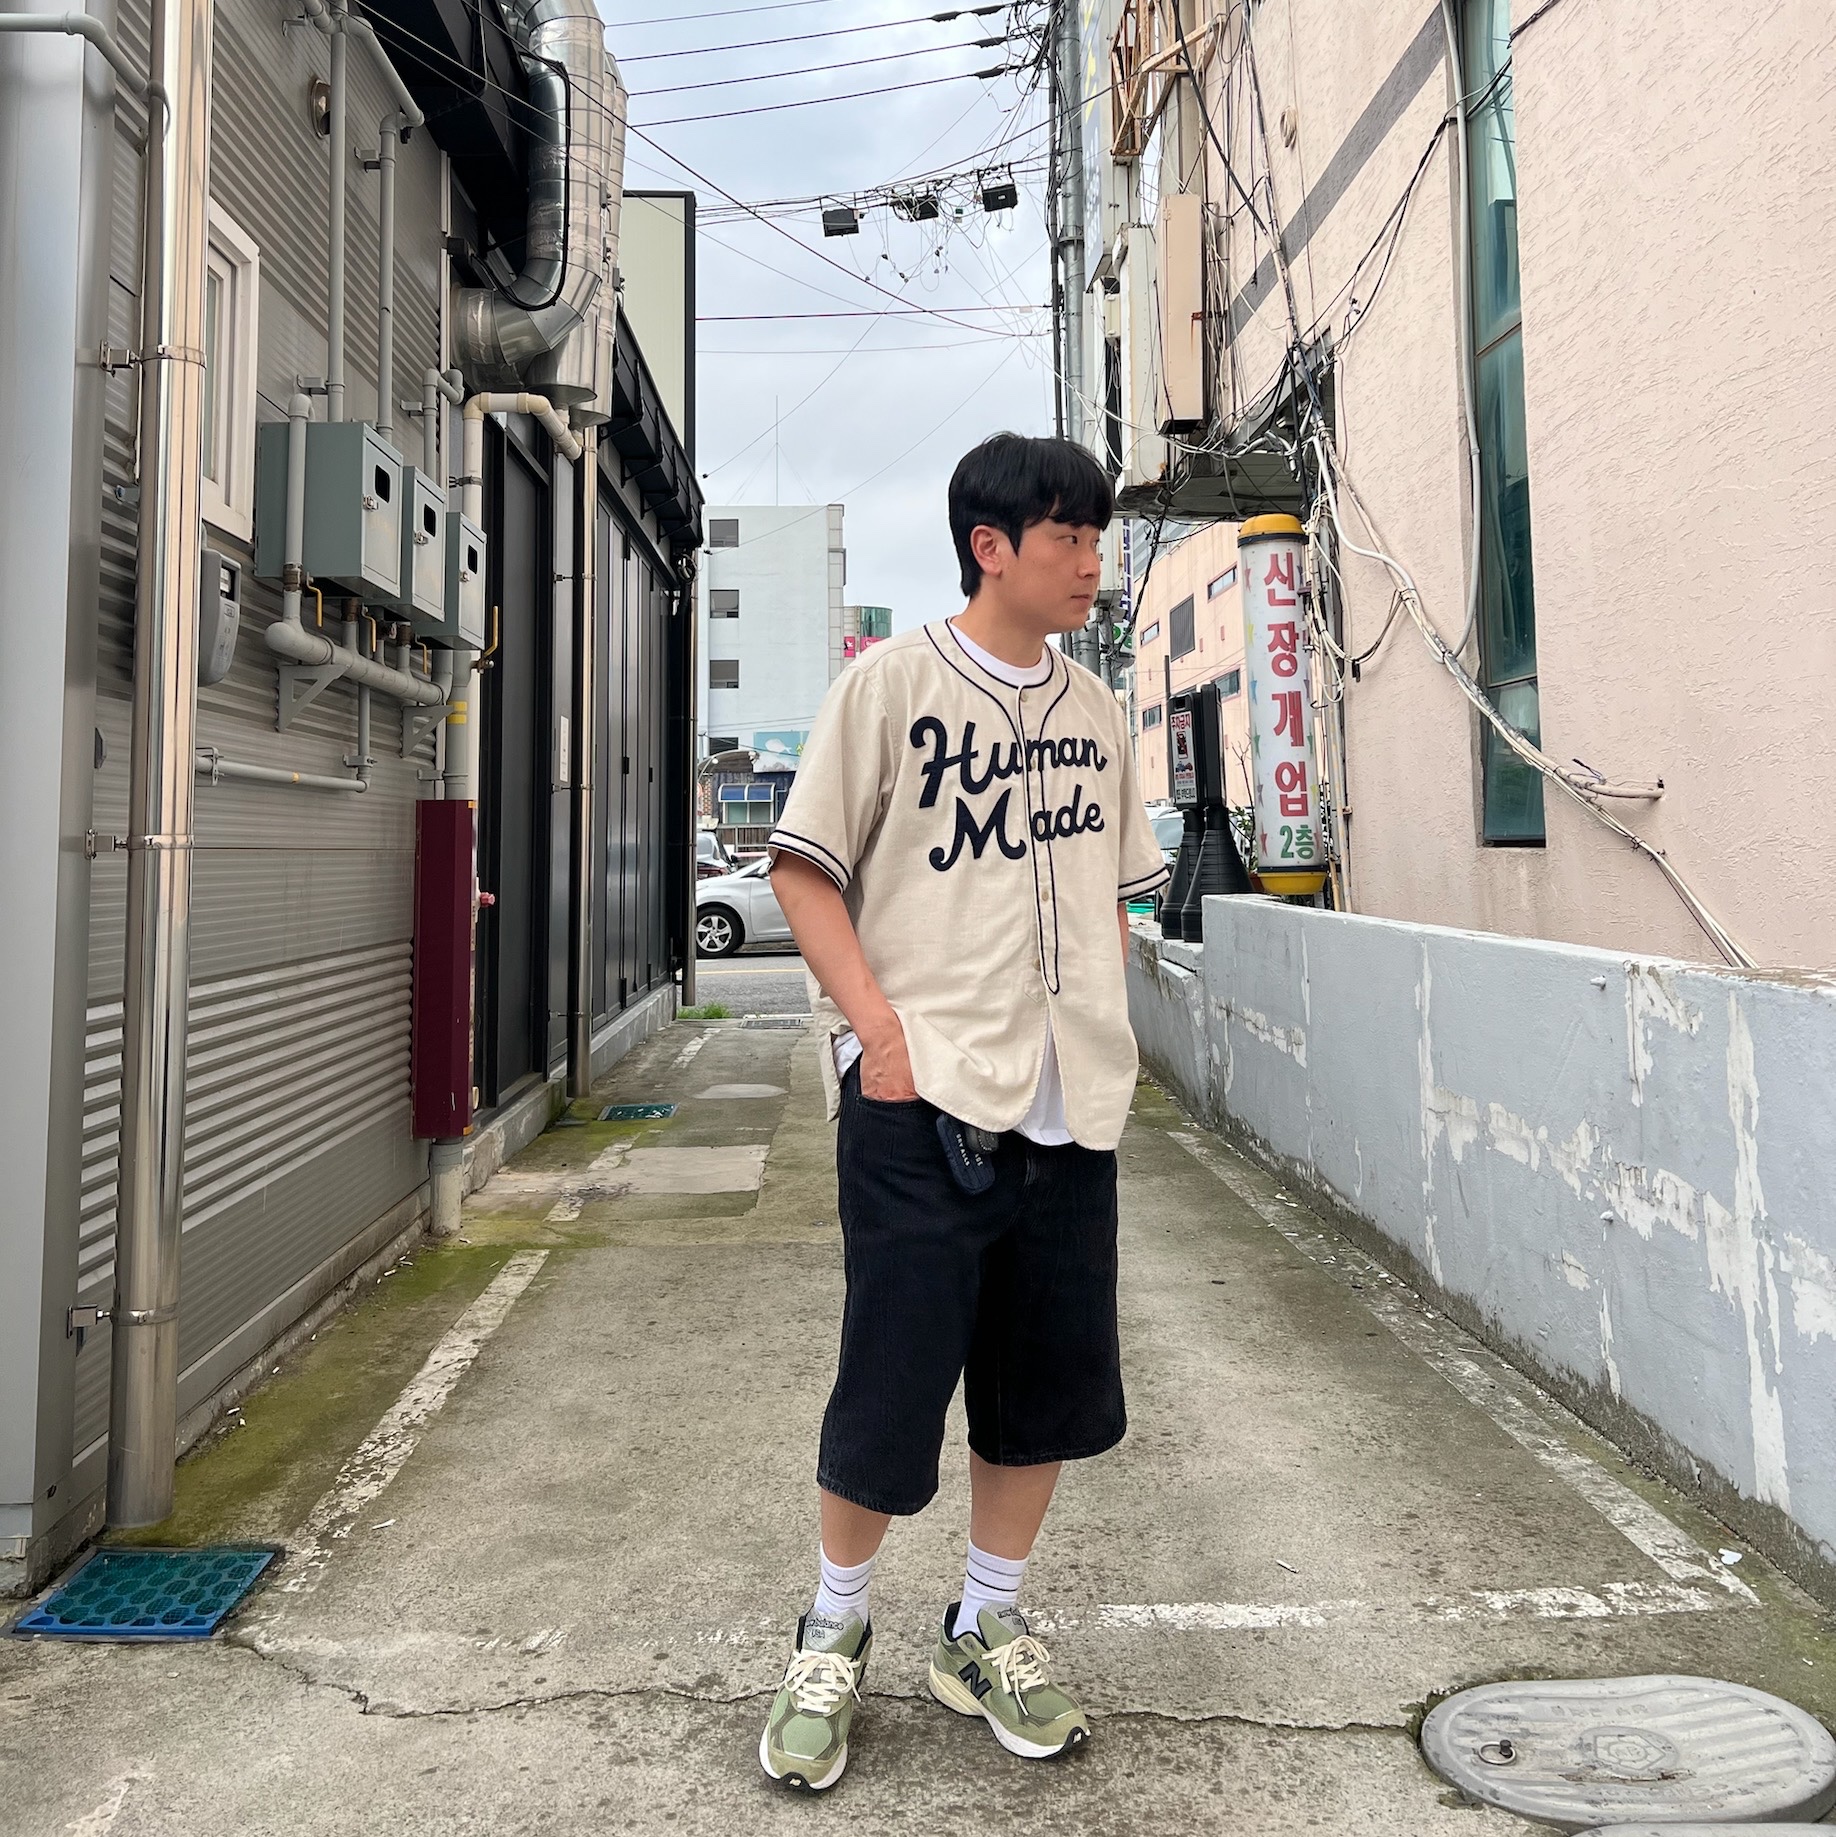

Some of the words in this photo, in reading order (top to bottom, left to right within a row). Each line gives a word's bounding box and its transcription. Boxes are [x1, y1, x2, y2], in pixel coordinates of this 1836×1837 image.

[1264, 551, 1309, 817] 신장개업
[909, 716, 1107, 808] Human
[929, 784, 1105, 872] Made
[1279, 824, 1316, 860] 2층
[958, 1660, 993, 1701] N
